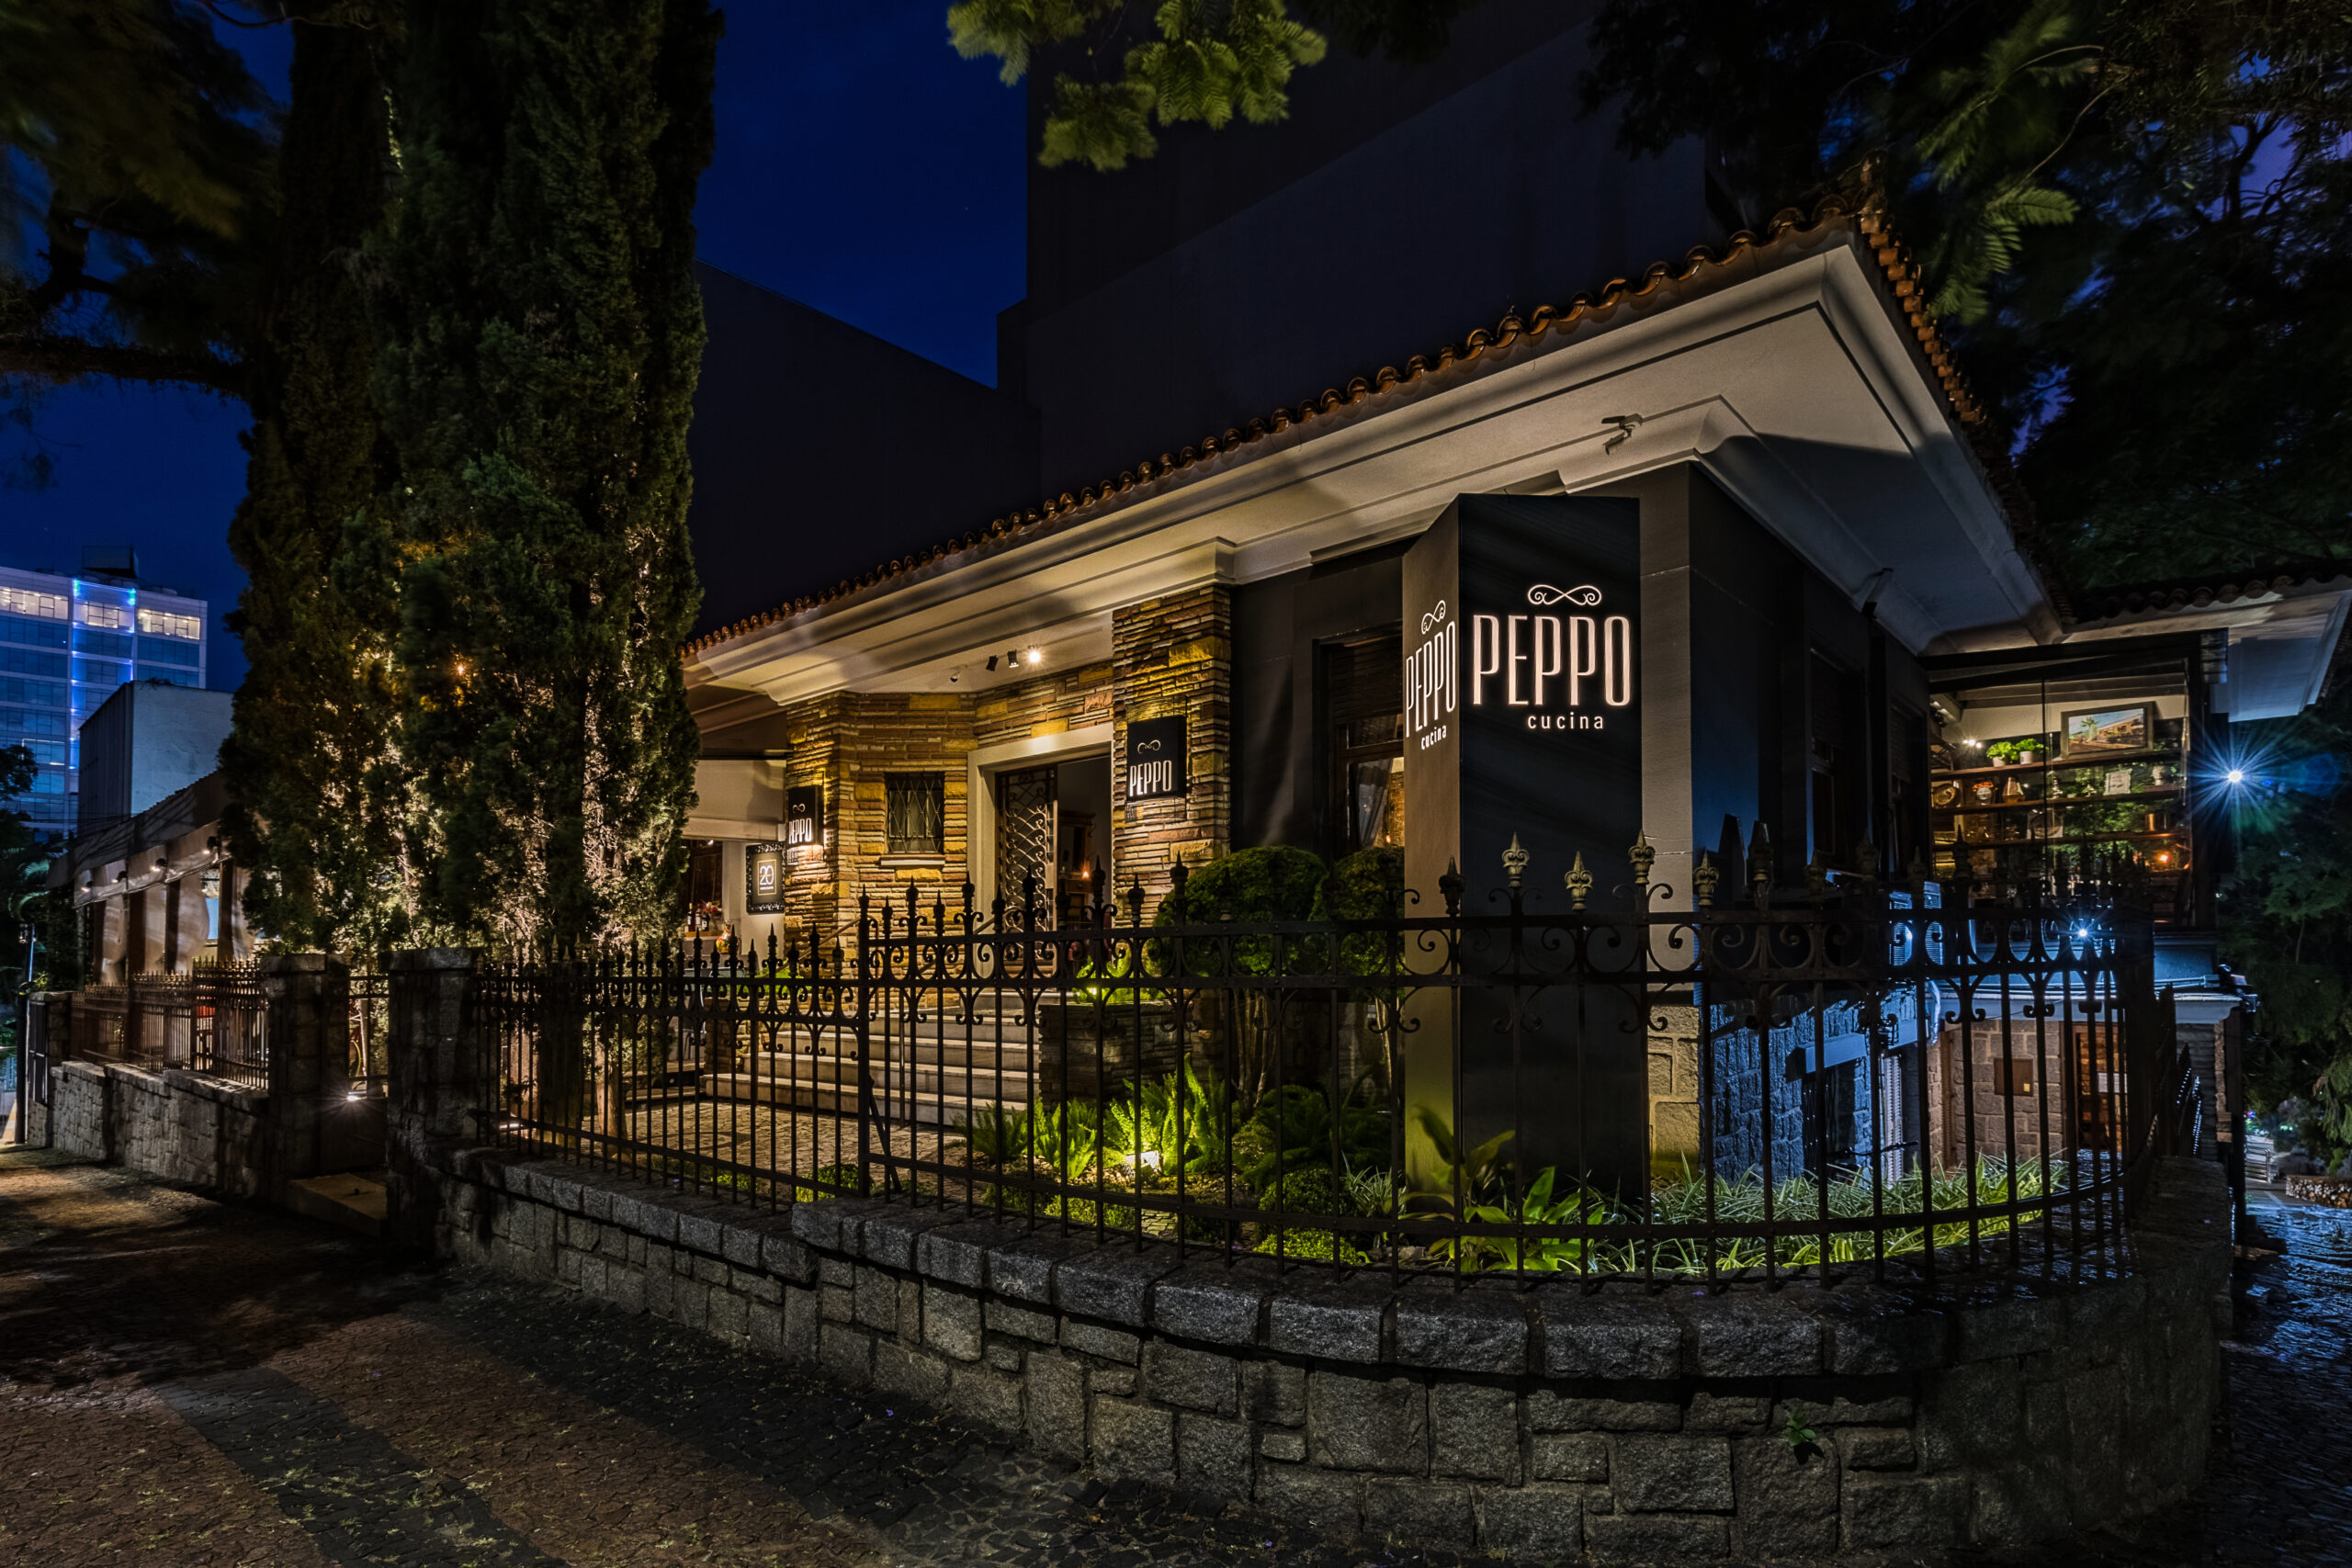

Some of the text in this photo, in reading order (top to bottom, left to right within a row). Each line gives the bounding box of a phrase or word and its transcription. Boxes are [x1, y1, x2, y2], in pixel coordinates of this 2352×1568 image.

[1473, 615, 1631, 706] PEPPO
[1406, 620, 1455, 739] PEPPO
[1527, 712, 1604, 729] cucina
[1421, 724, 1447, 750] cucina
[1129, 760, 1172, 797] PEPPO
[788, 818, 812, 845] PEPPO
[759, 864, 775, 886] 20
